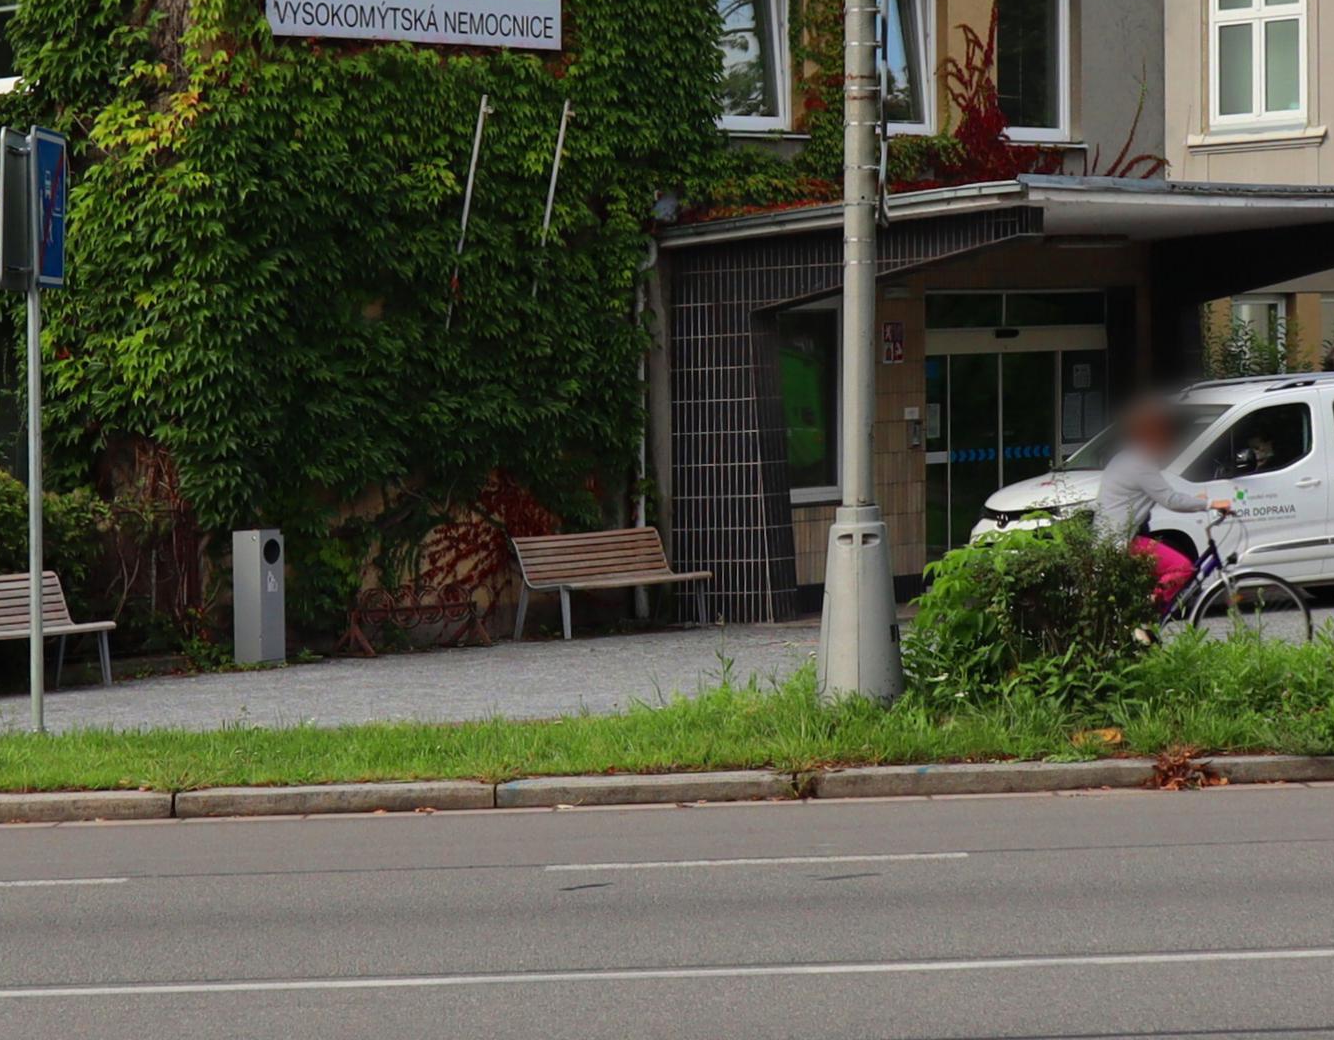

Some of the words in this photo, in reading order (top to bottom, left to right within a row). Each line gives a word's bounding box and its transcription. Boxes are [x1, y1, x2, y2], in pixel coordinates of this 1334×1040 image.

[274, 0, 438, 33] VYSOKOMÝTSKÁ
[444, 12, 555, 39] NEMOCNICE
[1253, 503, 1296, 517] DOPRAVA
